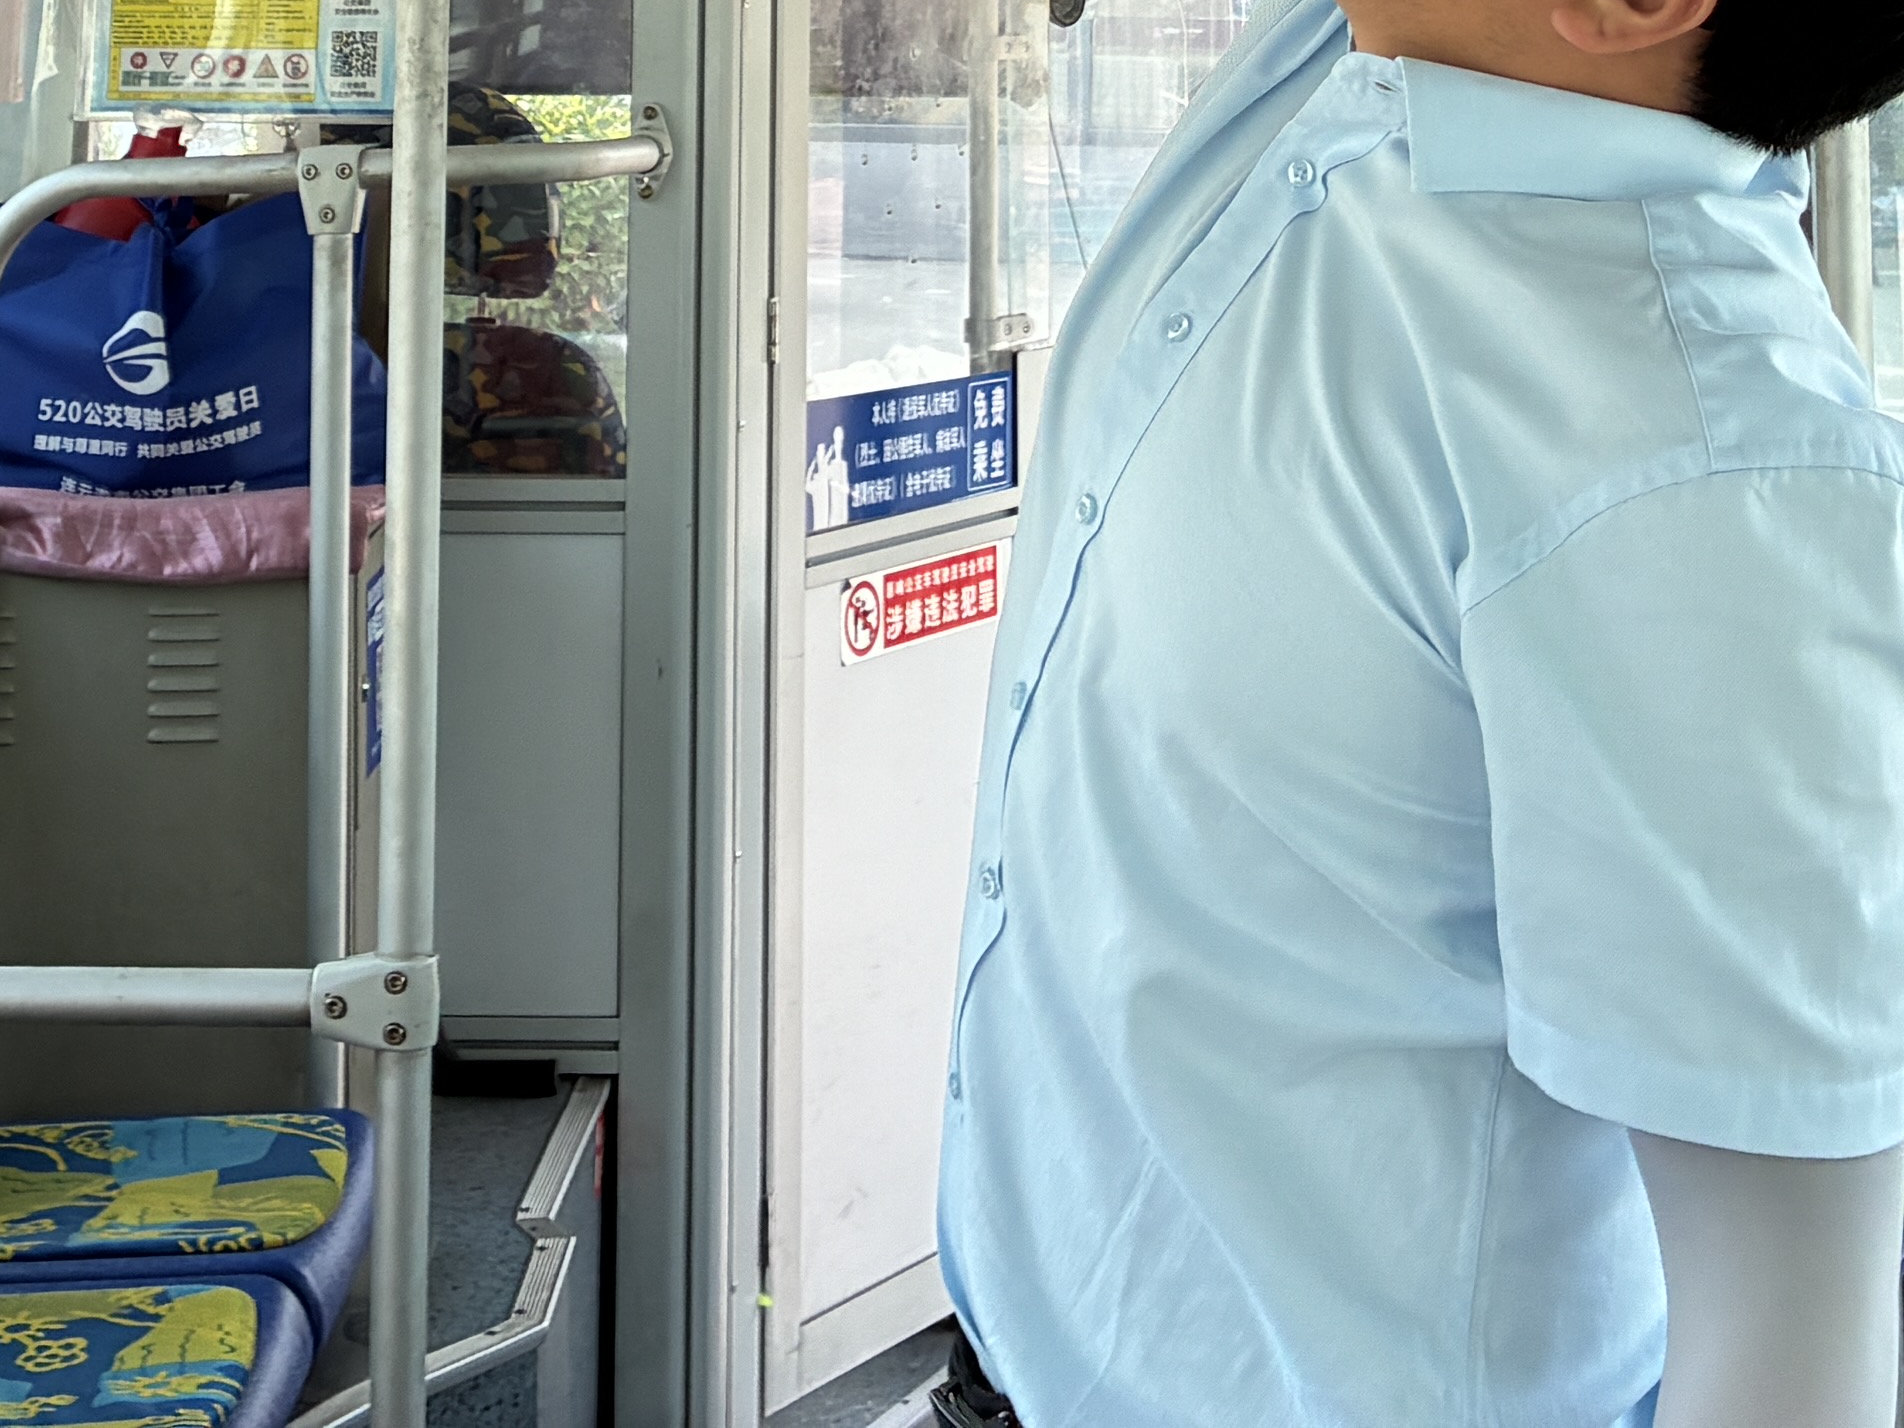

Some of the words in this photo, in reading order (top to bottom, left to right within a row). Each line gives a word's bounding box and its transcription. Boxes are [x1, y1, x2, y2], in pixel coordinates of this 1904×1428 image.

[37, 385, 260, 432] 520公交驾驶员关爱日
[136, 421, 262, 459] 共同关爱公交驾驶员
[886, 578, 995, 641] 涉嫌违法犯罪
